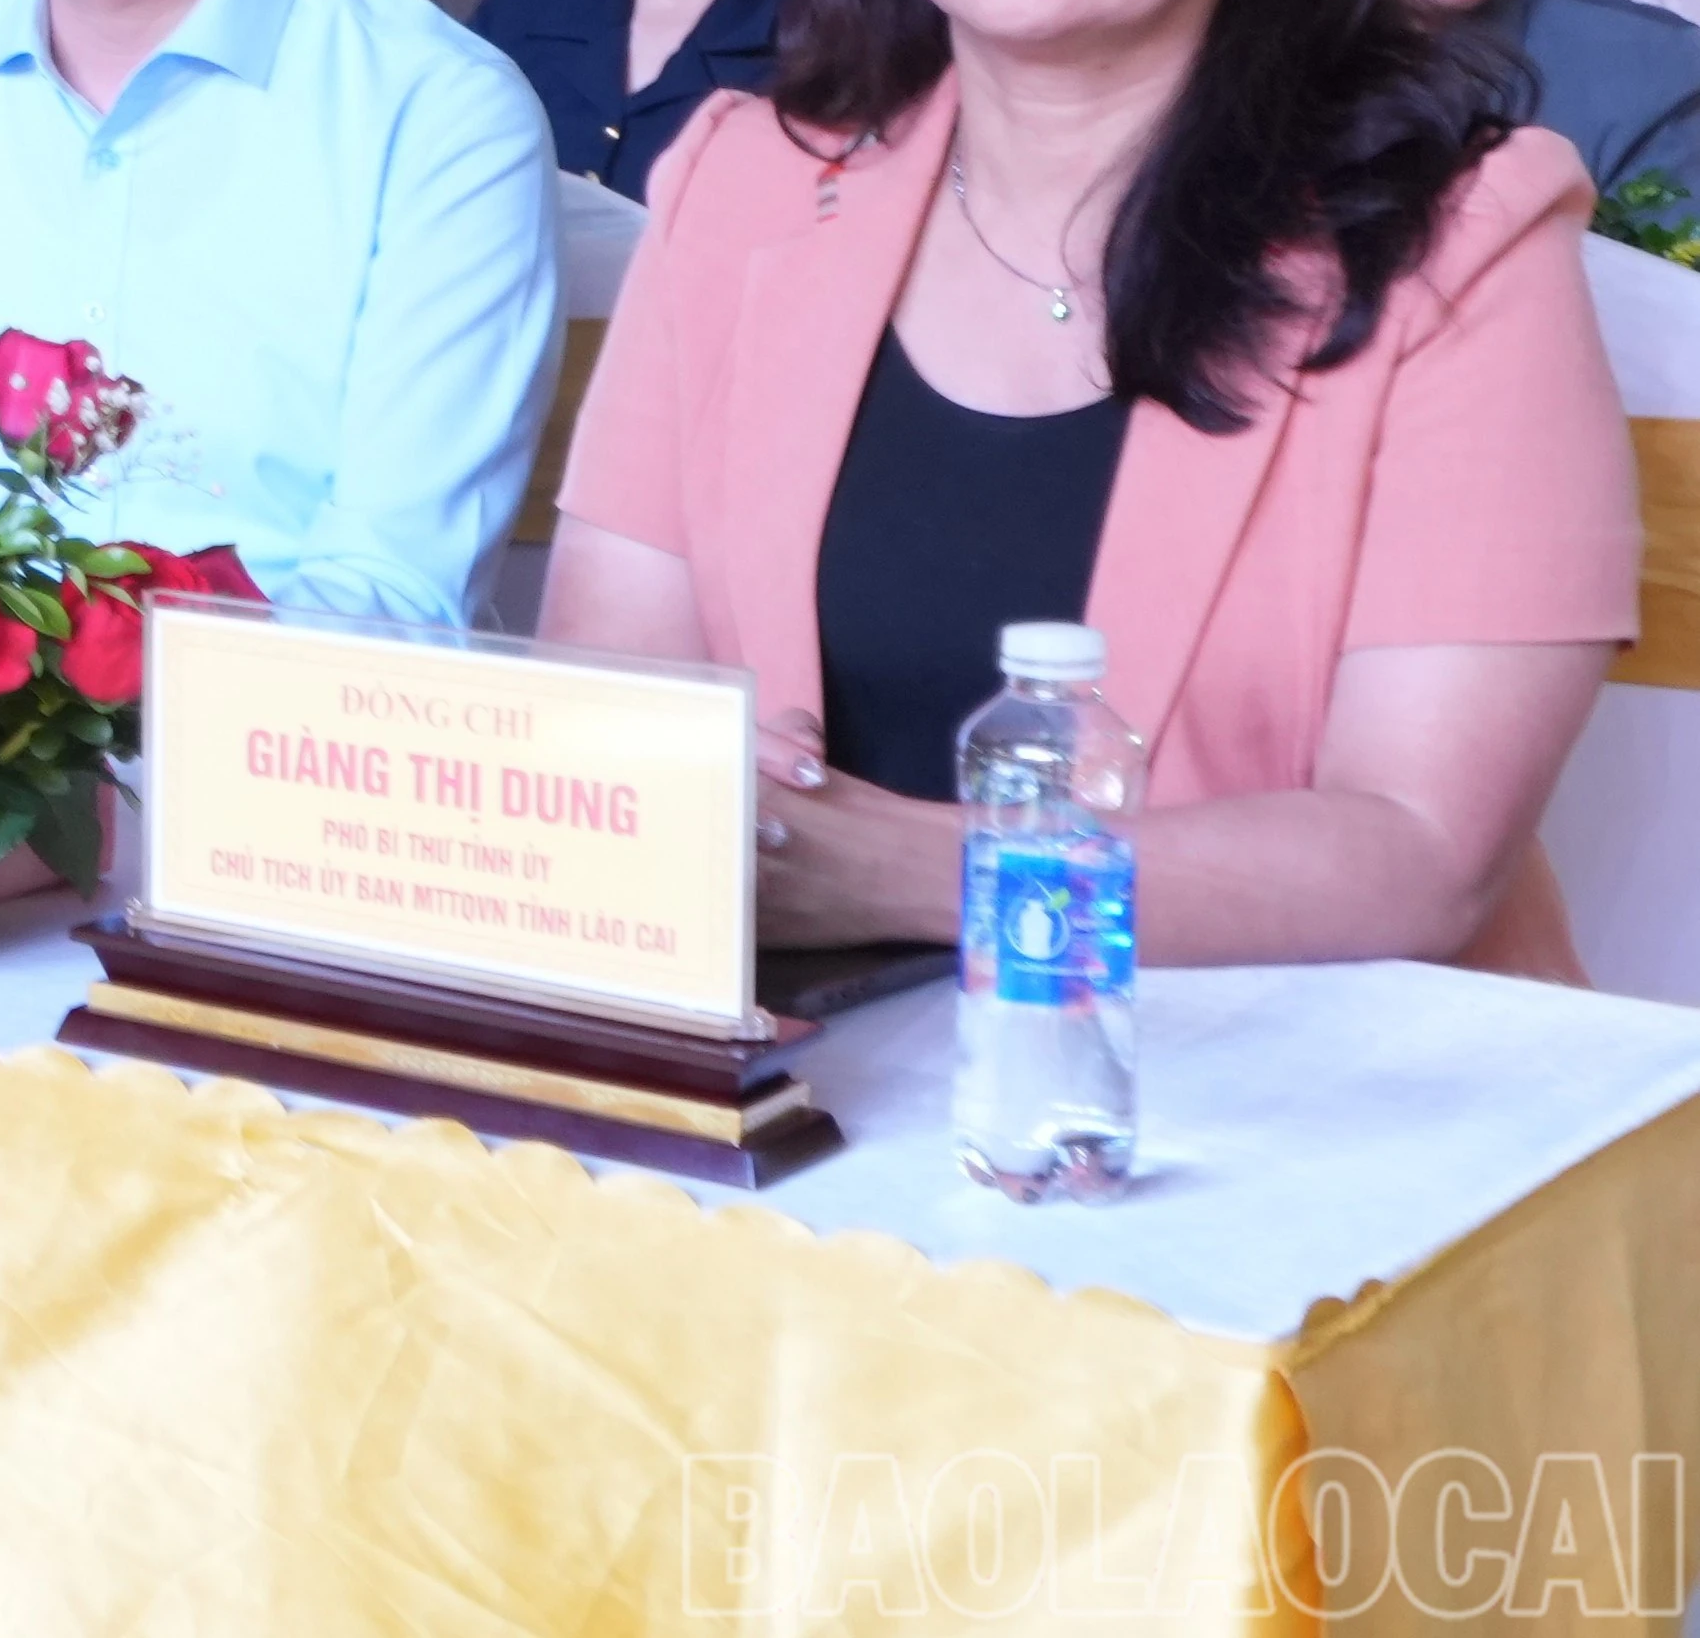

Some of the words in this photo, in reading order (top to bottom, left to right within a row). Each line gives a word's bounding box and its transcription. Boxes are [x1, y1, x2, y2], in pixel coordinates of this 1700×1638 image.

[340, 680, 452, 730] ĐỒNG
[464, 701, 534, 742] CHÍ
[247, 724, 390, 798] GIÀNG
[408, 753, 483, 824] THỊ
[500, 767, 639, 837] DUNG
[322, 816, 368, 852] PHÓ
[376, 826, 399, 857] BÍ
[409, 832, 455, 865] THƯ
[460, 836, 513, 877] TỈNH
[523, 842, 553, 883] ỦY
[210, 844, 254, 880] CHỦ
[262, 857, 311, 893] TỊCH
[320, 856, 350, 896] ỦY
[356, 874, 404, 908] BAN
[413, 883, 508, 927] MTTQVN
[516, 895, 572, 938] TỈNH
[580, 909, 625, 947] LÀO
[635, 923, 678, 957] CAI
